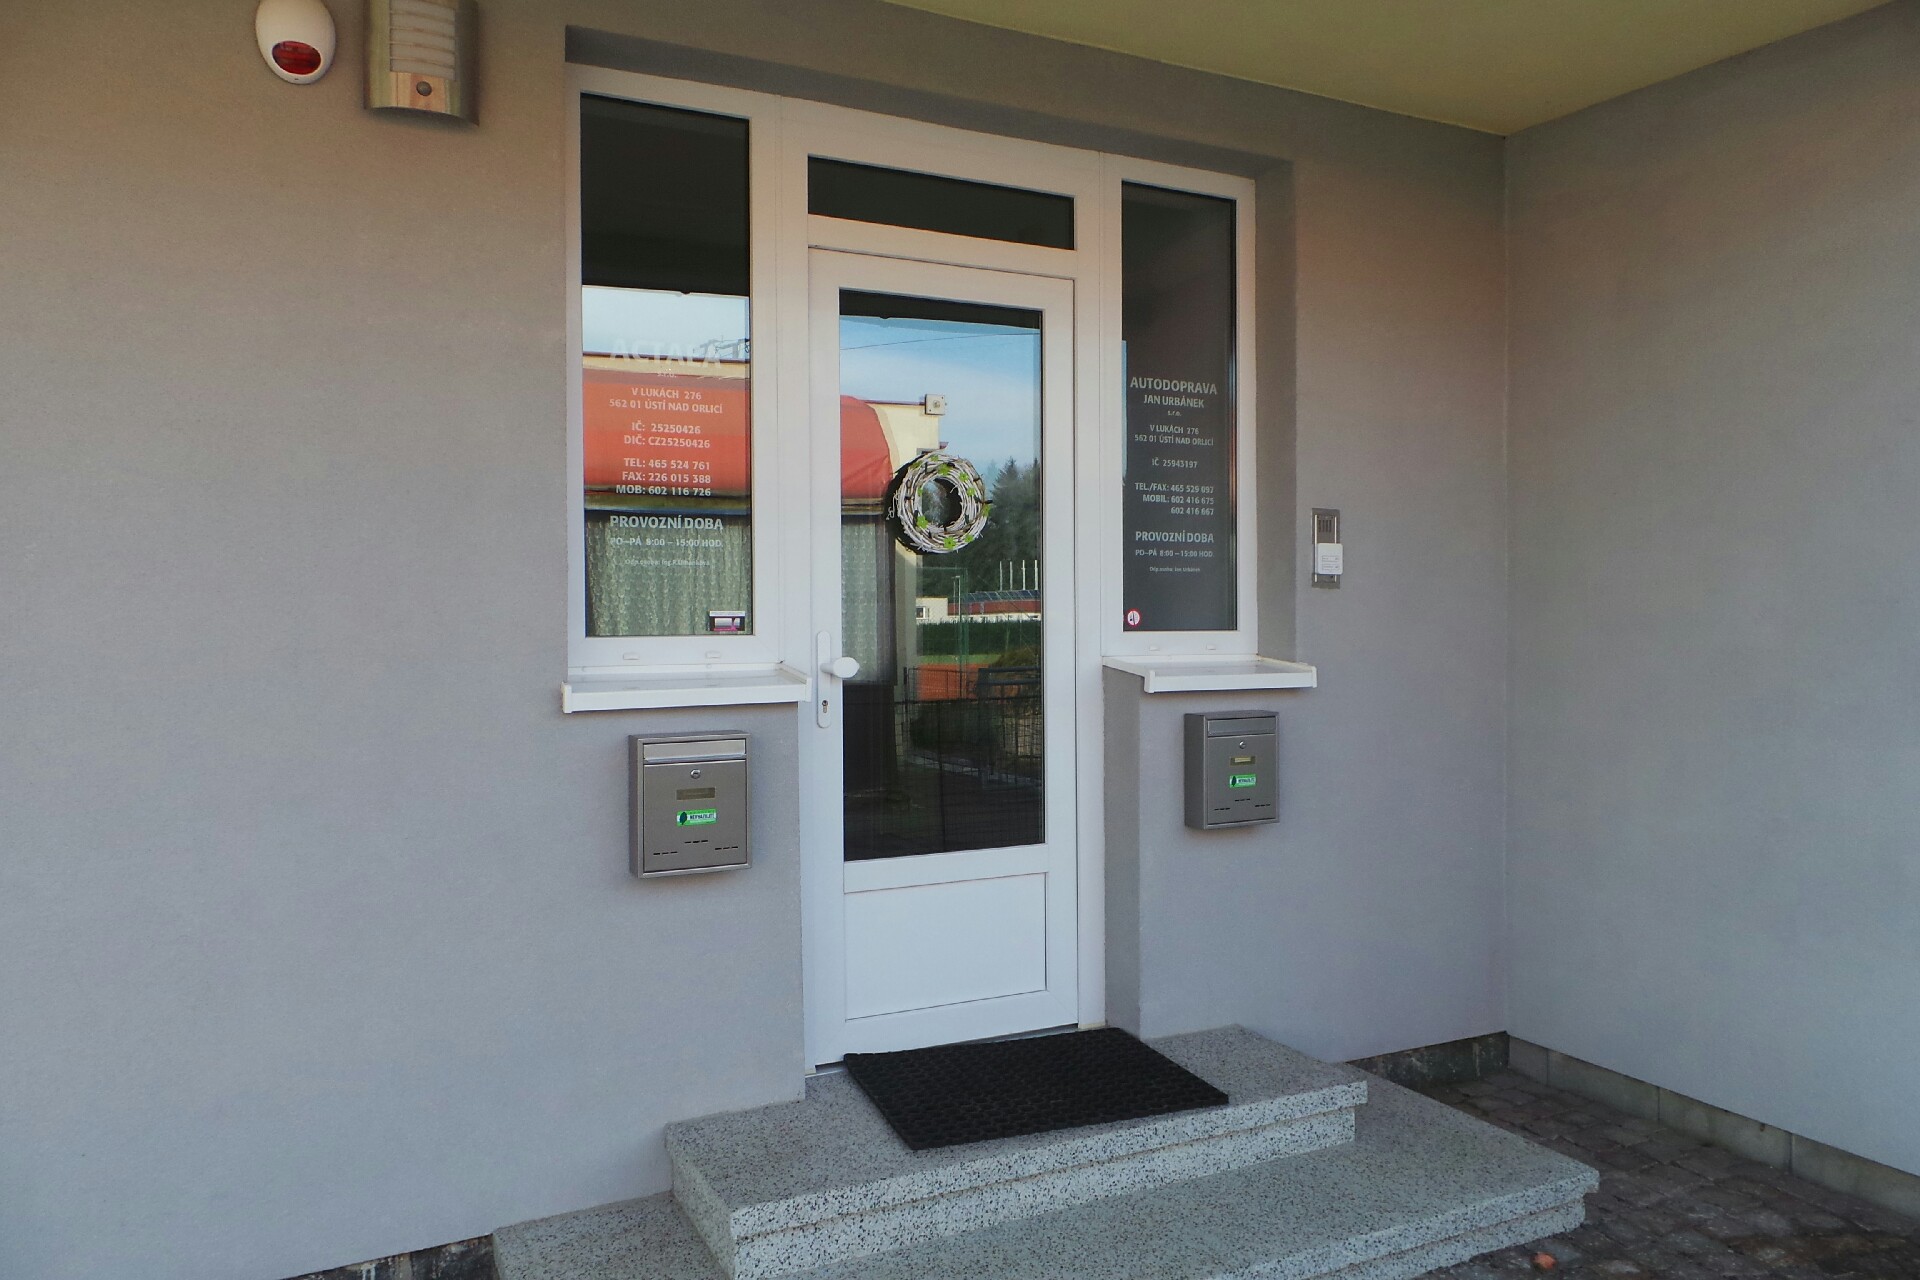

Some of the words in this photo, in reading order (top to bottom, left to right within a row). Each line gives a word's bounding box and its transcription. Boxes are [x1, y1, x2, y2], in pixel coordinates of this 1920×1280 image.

[1130, 376, 1218, 395] AUTODOPRAVA
[632, 388, 639, 396] V
[640, 386, 679, 399] LUKÁCH
[684, 391, 702, 400] 276
[610, 399, 628, 408] 562
[630, 400, 641, 409] 01
[644, 398, 666, 411] ÚSTÍ
[668, 402, 689, 412] NAD
[692, 403, 723, 414] ORLICÍ
[1144, 394, 1160, 404] JAN
[1162, 396, 1204, 408] URBÁNEK
[632, 420, 645, 431] IČ:
[651, 423, 701, 434] 25250426
[1156, 424, 1183, 434] LUKÁCH
[624, 434, 646, 445] DIČ:
[648, 436, 710, 449] CZ25250426
[1135, 434, 1147, 442] 562
[1175, 437, 1190, 445] NAD
[624, 458, 646, 468] TEL:
[648, 459, 667, 469] 465
[670, 460, 689, 470] 524
[692, 461, 710, 470] 761
[622, 471, 646, 481] FAX:
[648, 472, 668, 482] 226
[670, 473, 690, 482] 015
[692, 474, 712, 484] 388
[616, 484, 646, 494] MOB:
[648, 486, 667, 496] 602
[672, 486, 690, 496] 116
[692, 487, 712, 497] 726
[1135, 482, 1169, 492] TEL./FAX:
[610, 514, 682, 529] PROVOZNÍ
[684, 518, 724, 530] DOBA
[1136, 530, 1185, 542] PROVOZNÍ
[1187, 533, 1214, 543] DOBA
